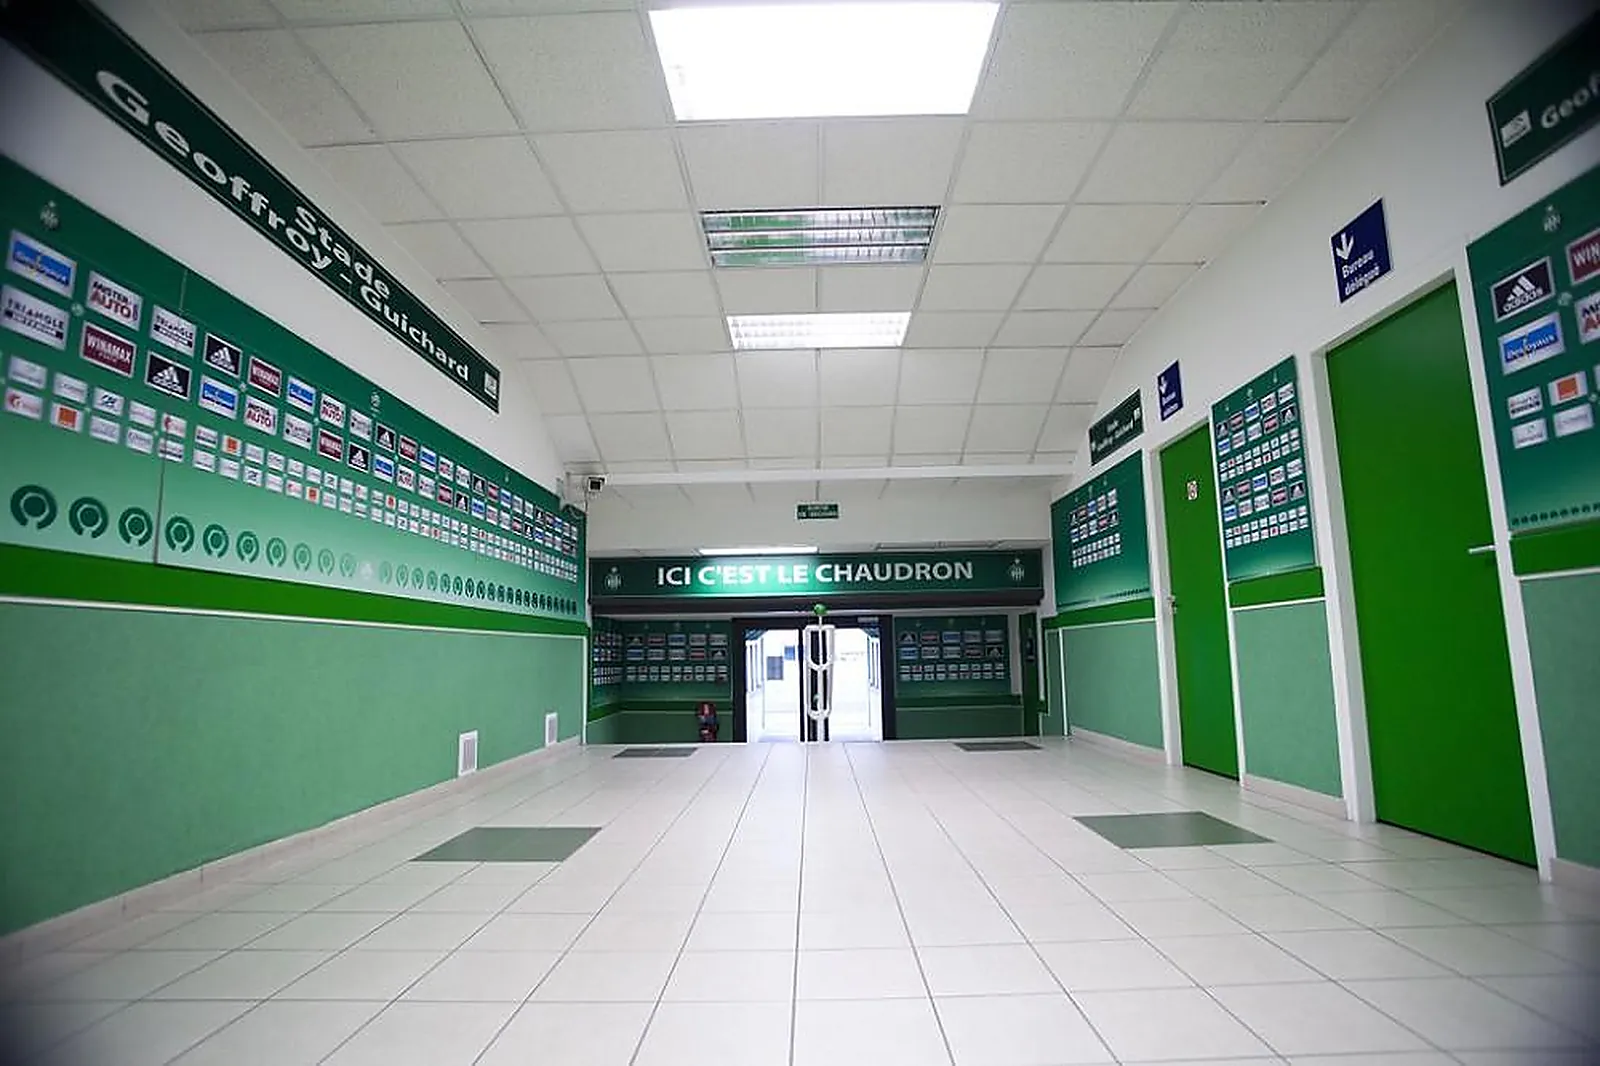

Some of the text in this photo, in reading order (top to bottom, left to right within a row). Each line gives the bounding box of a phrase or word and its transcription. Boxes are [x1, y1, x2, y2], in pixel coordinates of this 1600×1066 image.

[97, 70, 333, 270] Geoffroy
[361, 287, 469, 382] Guichard
[296, 206, 390, 299] Stade
[7, 297, 65, 330] TRIANGLE
[90, 287, 132, 319] AUTO
[1503, 287, 1544, 313] adidas
[87, 332, 132, 363] WINAMAX
[657, 561, 974, 586] ICI C'EST LE CHAUDRON
